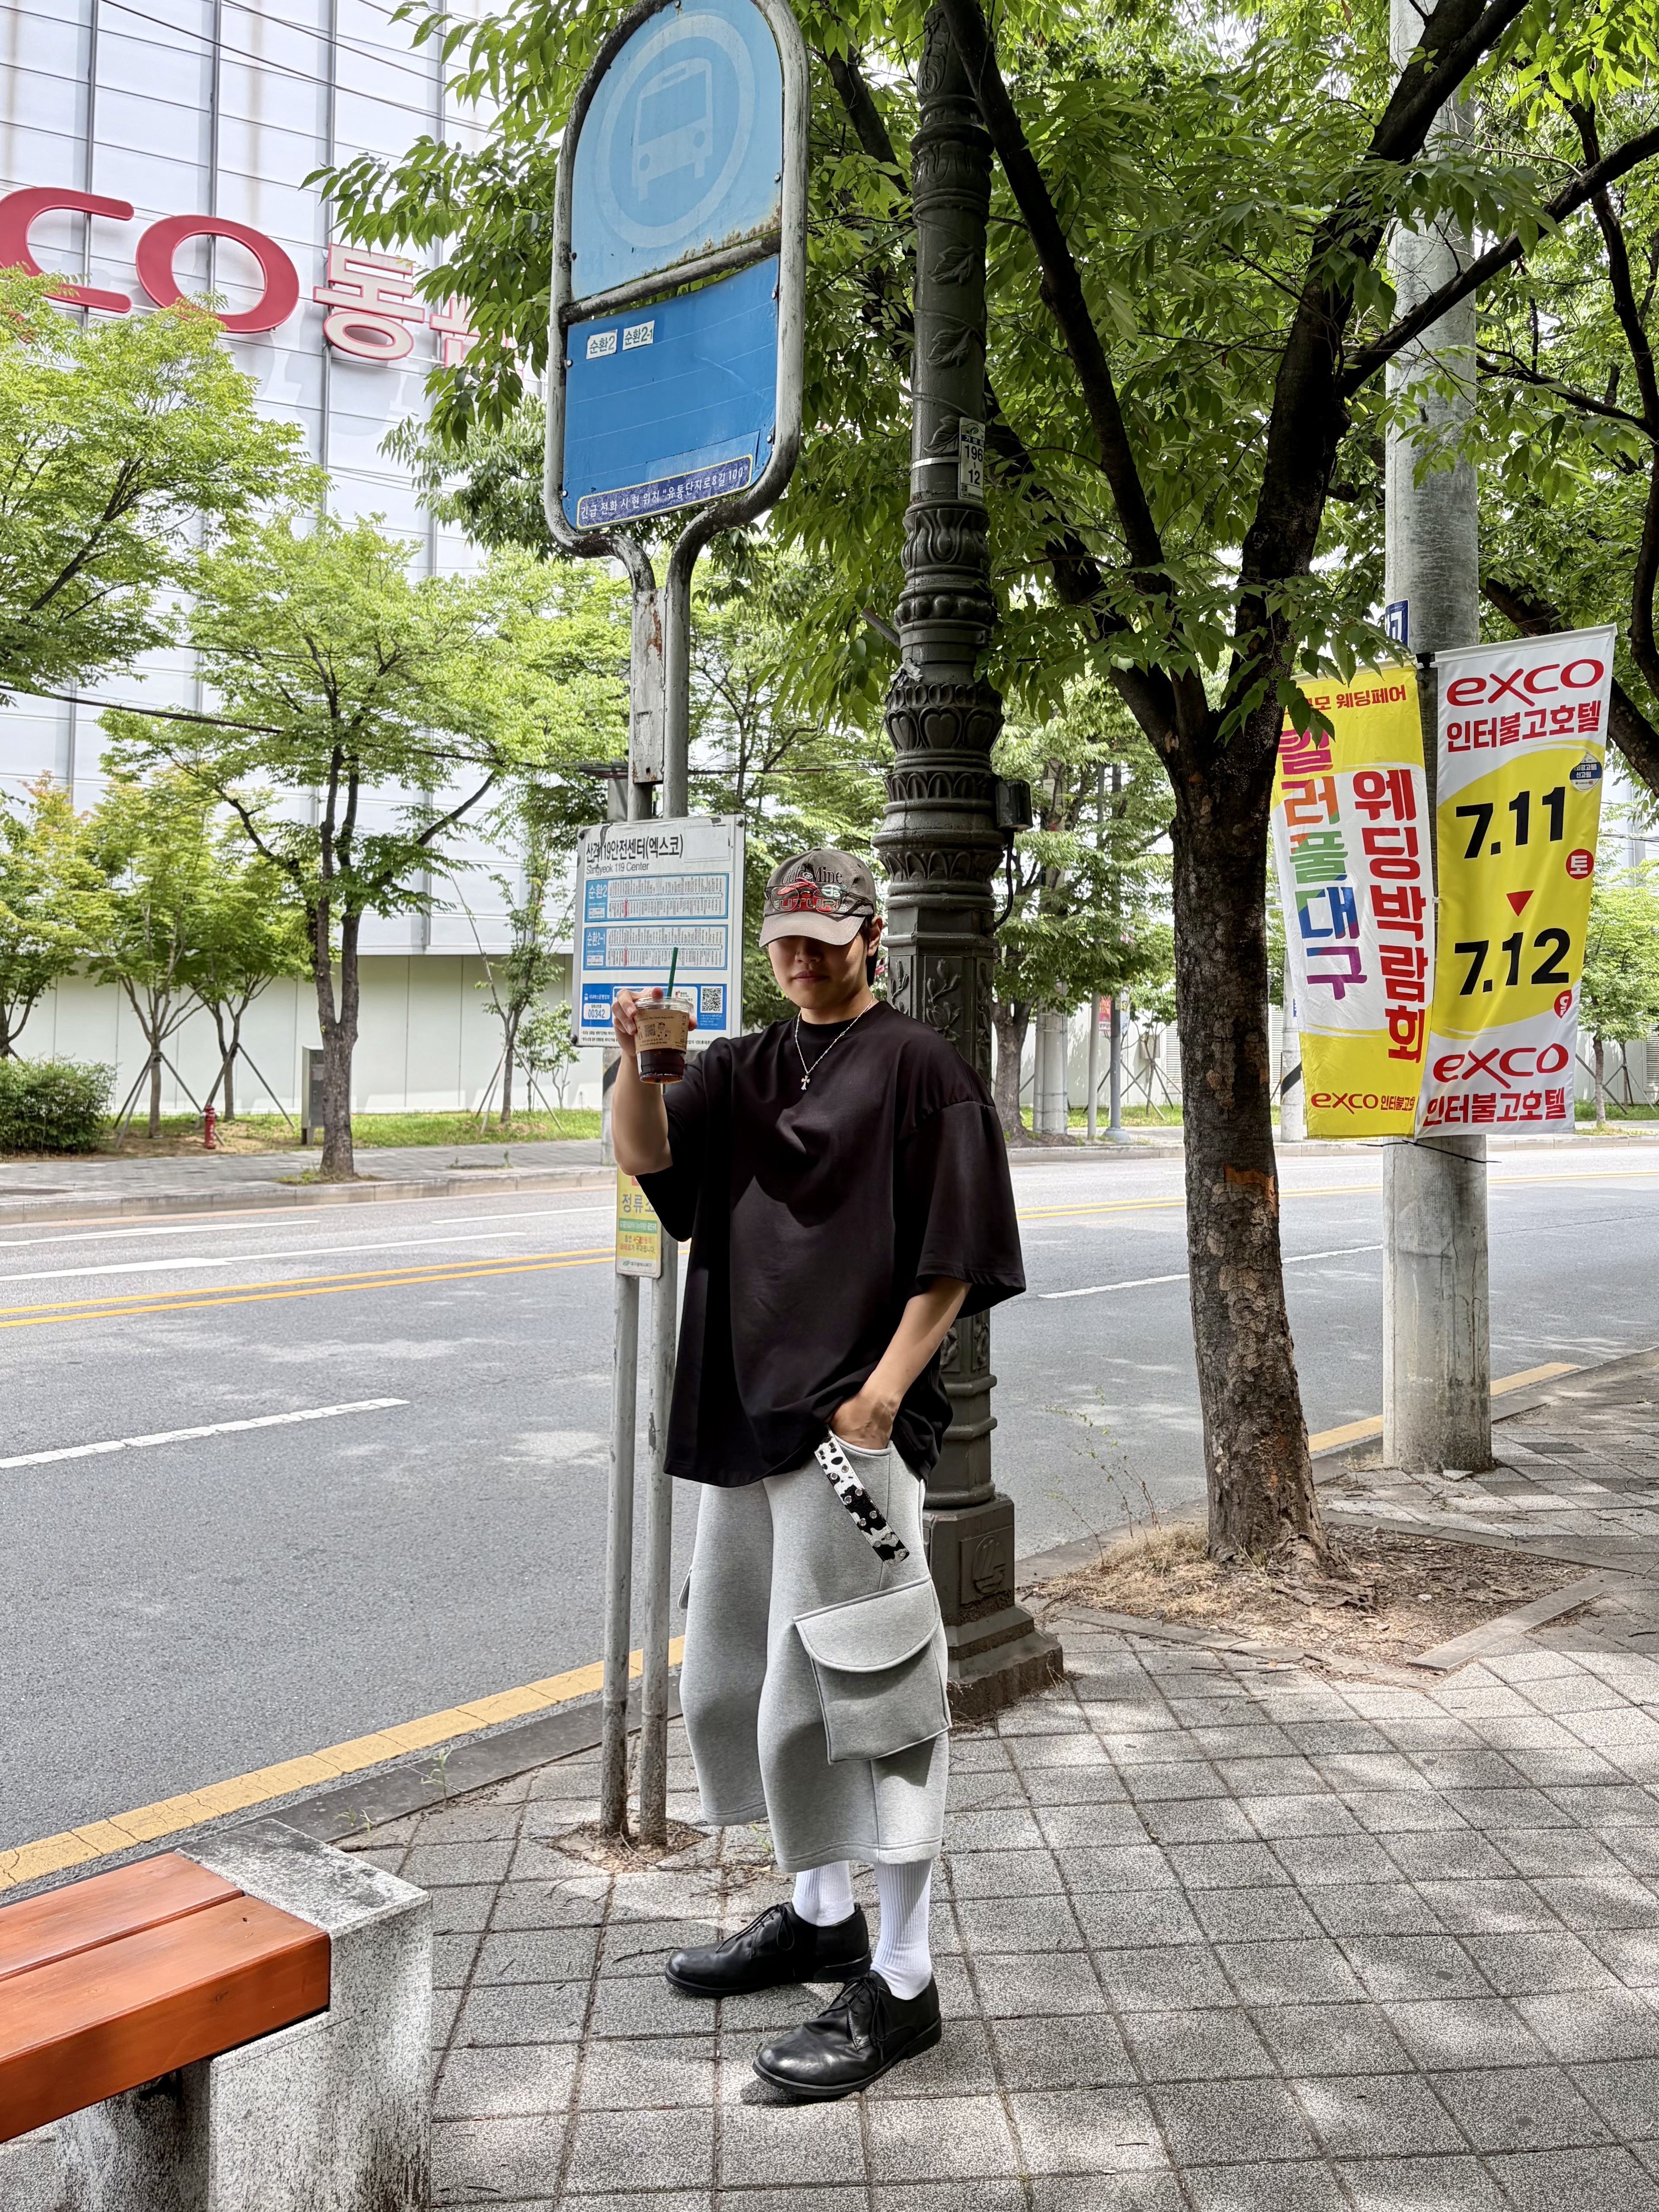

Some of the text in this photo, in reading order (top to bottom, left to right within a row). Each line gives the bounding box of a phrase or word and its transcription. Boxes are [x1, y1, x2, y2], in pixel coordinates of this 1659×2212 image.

[589, 335, 615, 354] 순환2
[625, 326, 653, 346] 순환2-1
[965, 444, 983, 462] 196
[968, 469, 980, 485] 12
[581, 505, 597, 519] 긴급
[601, 500, 618, 516] 전화
[621, 497, 628, 510] 시
[632, 495, 640, 509] 현
[643, 490, 659, 505] 위치
[1447, 659, 1604, 707] exco
[1336, 684, 1407, 709] 웨딩페어
[1447, 699, 1600, 752] 인터불고호텔
[1456, 786, 1565, 859] 7.11
[586, 861, 650, 876] Sangyeok 119 Center
[1570, 855, 1588, 875] 토
[810, 866, 843, 885] Mine
[589, 884, 608, 900] 순환2
[1352, 769, 1428, 1063] 웨딩박람회
[587, 931, 605, 947] 순환2-1
[1455, 928, 1570, 996] 7.12
[588, 1009, 605, 1018] 00342
[1433, 1043, 1569, 1089] exco
[1311, 1093, 1379, 1114] exco
[1423, 1086, 1566, 1127] 인터불고호텔
